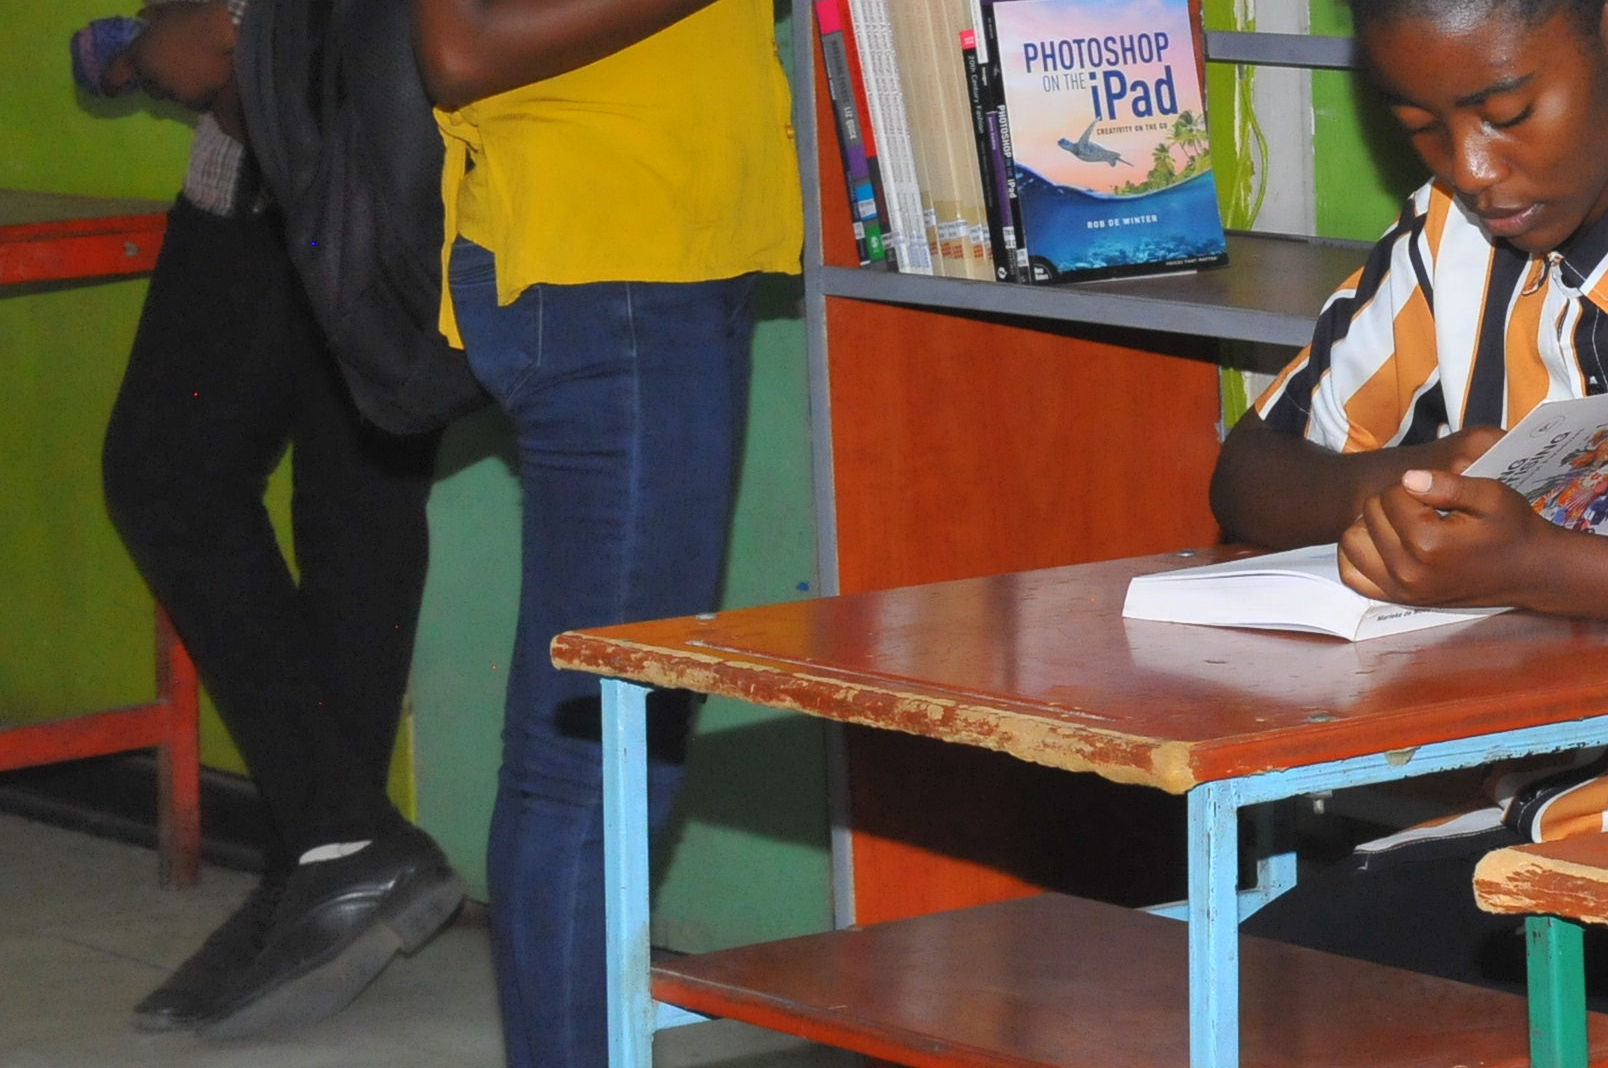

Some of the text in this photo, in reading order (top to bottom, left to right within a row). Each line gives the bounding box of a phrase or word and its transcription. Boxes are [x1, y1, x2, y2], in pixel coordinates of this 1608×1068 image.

[1023, 32, 1169, 74] PHOTOSHOP
[1042, 64, 1179, 121] ON THE iPad
[997, 105, 1012, 159] PHOTOSHOP
[1008, 178, 1017, 199] iPad
[1087, 215, 1158, 229] ROB DE WINTER
